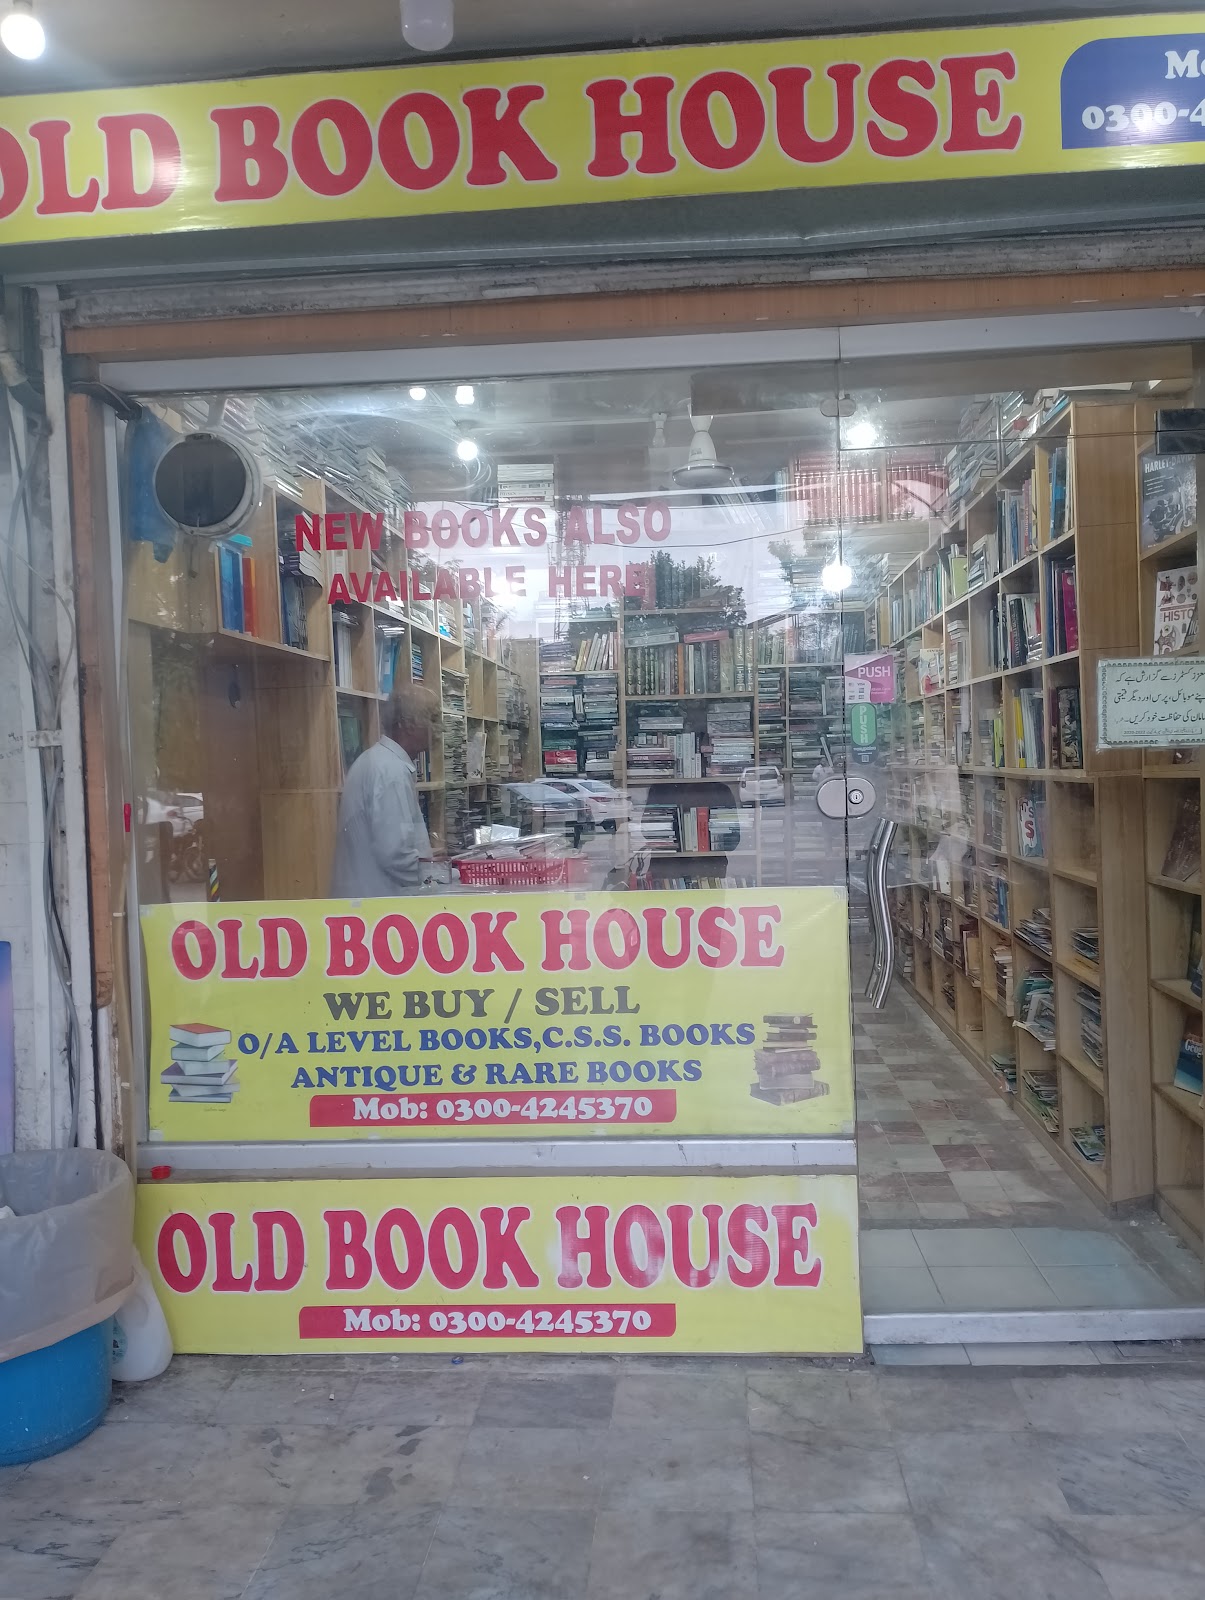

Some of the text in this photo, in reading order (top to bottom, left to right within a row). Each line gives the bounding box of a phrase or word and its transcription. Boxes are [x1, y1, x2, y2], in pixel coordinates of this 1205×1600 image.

[1165, 50, 1205, 79] M
[211, 85, 557, 201] BOOK
[586, 52, 1022, 177] HOUSE
[295, 502, 671, 551] NEW BOOKS ALSO
[328, 564, 645, 604] AVAILABLE HERE
[858, 665, 891, 678] PUSH
[859, 705, 869, 743] PUSH
[172, 905, 785, 981] OLD BOOK HOUSE
[323, 985, 641, 1024] WE BUY / SELL
[238, 1032, 300, 1060] O/A
[307, 1030, 411, 1053] LEVEL
[640, 1023, 756, 1047] BOOKS
[291, 1059, 702, 1092] ANTIQUE & RARE BOOKS
[352, 1096, 653, 1122] Mob: 0300-4245370
[158, 1202, 822, 1294] OLD BOOK HOUSE
[343, 1309, 652, 1334] Mob: 0300-4245370
